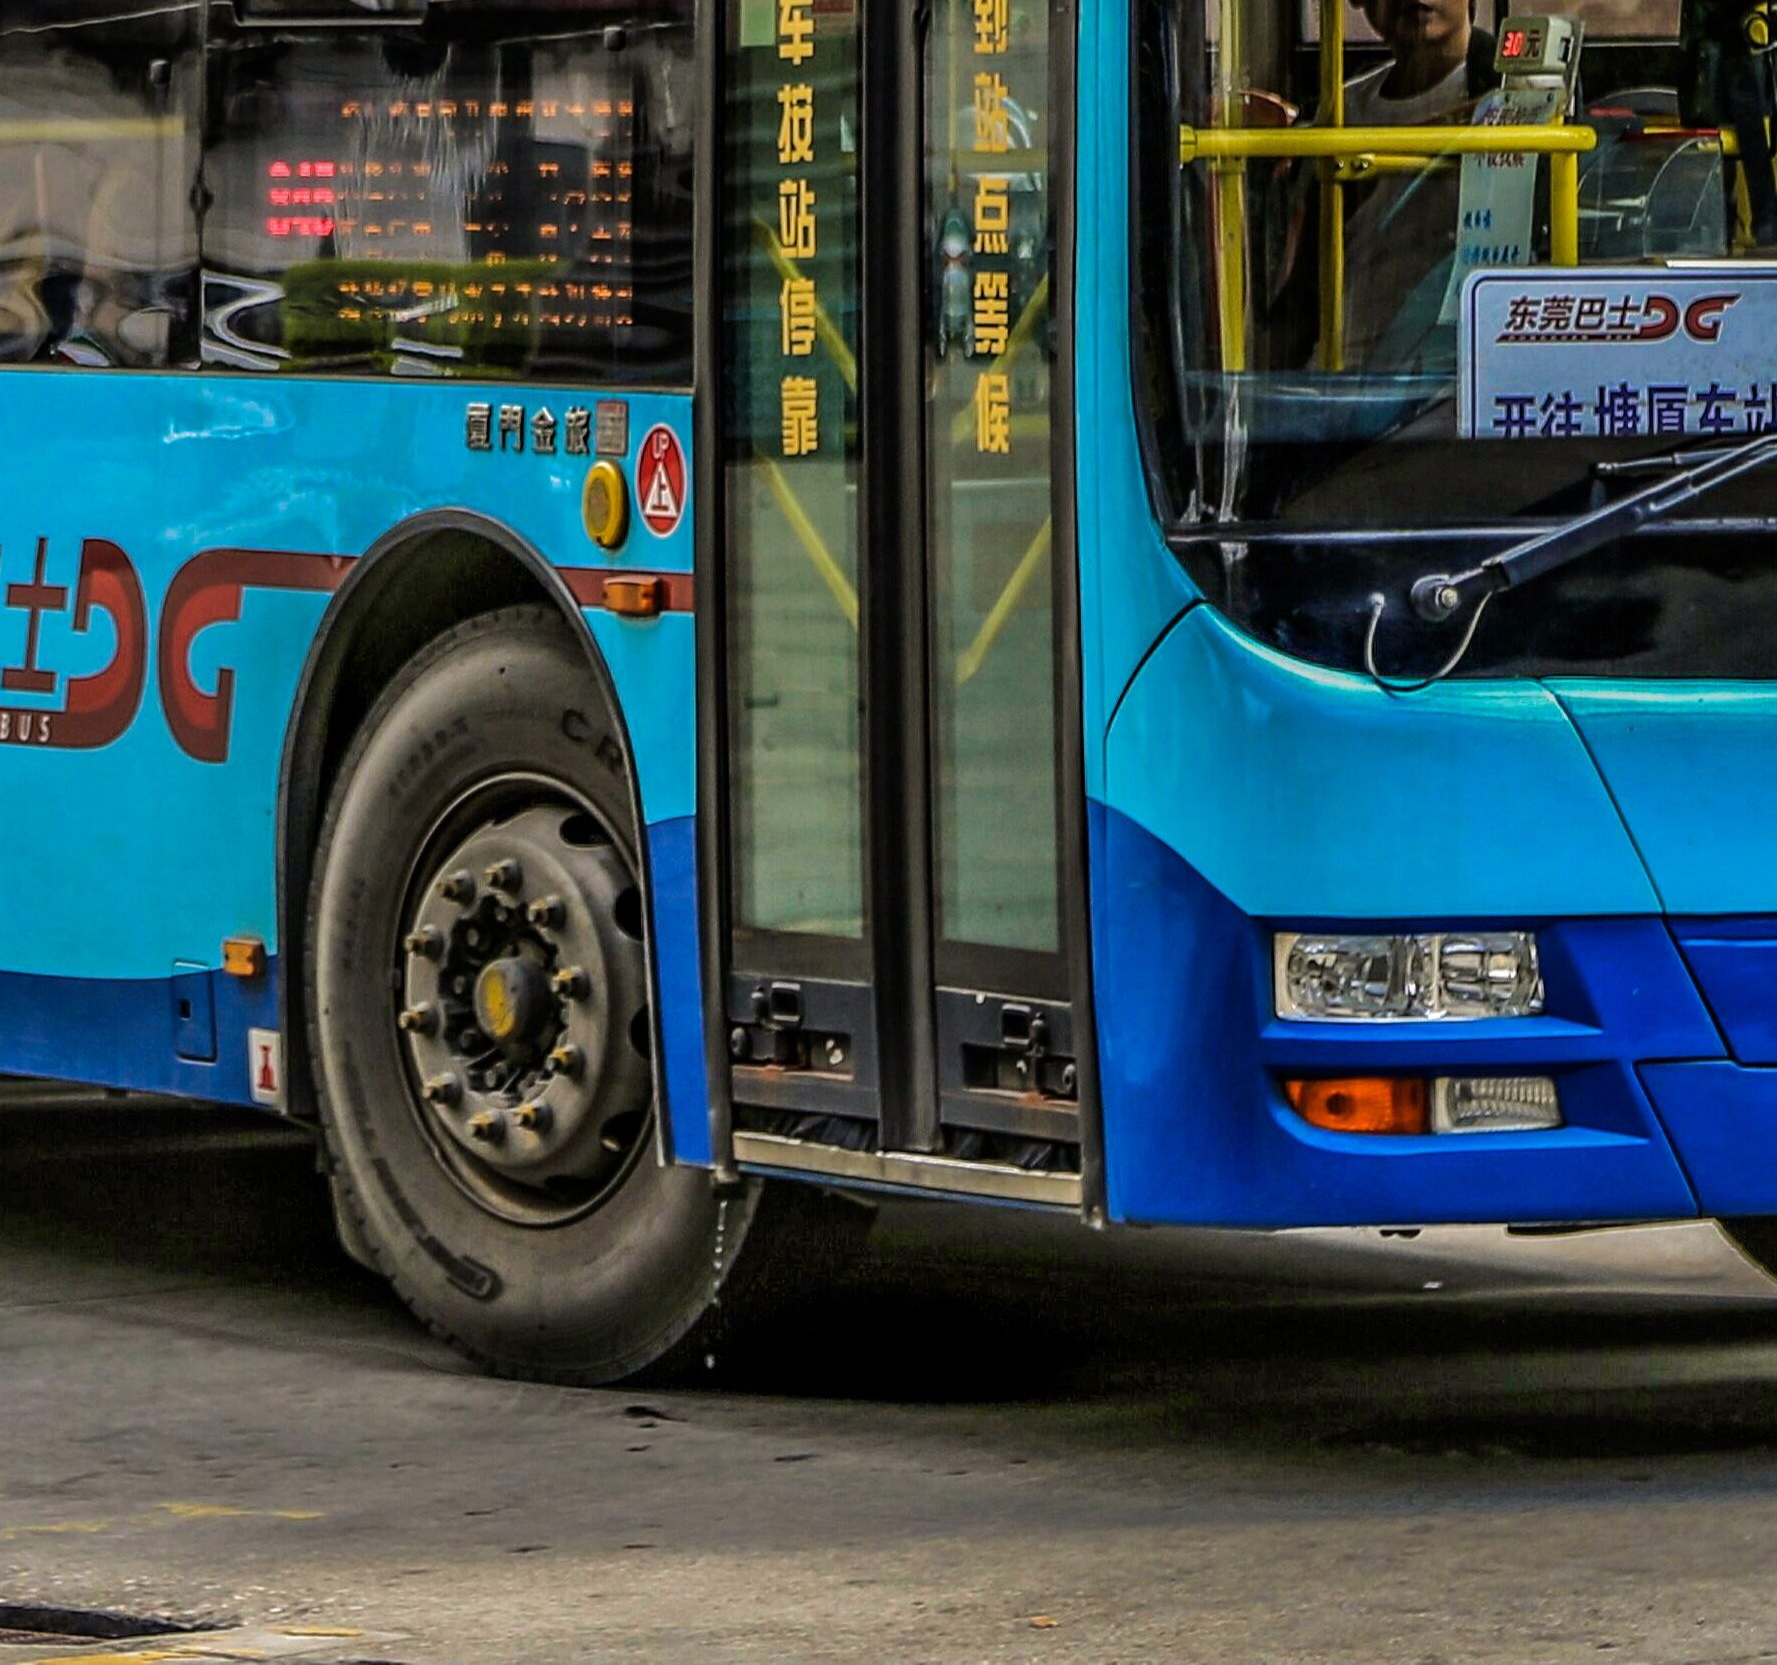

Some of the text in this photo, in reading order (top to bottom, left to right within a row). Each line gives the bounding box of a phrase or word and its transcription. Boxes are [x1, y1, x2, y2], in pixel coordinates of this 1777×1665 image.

[1505, 293, 1641, 332] 东莞巴士
[652, 432, 671, 460] UP
